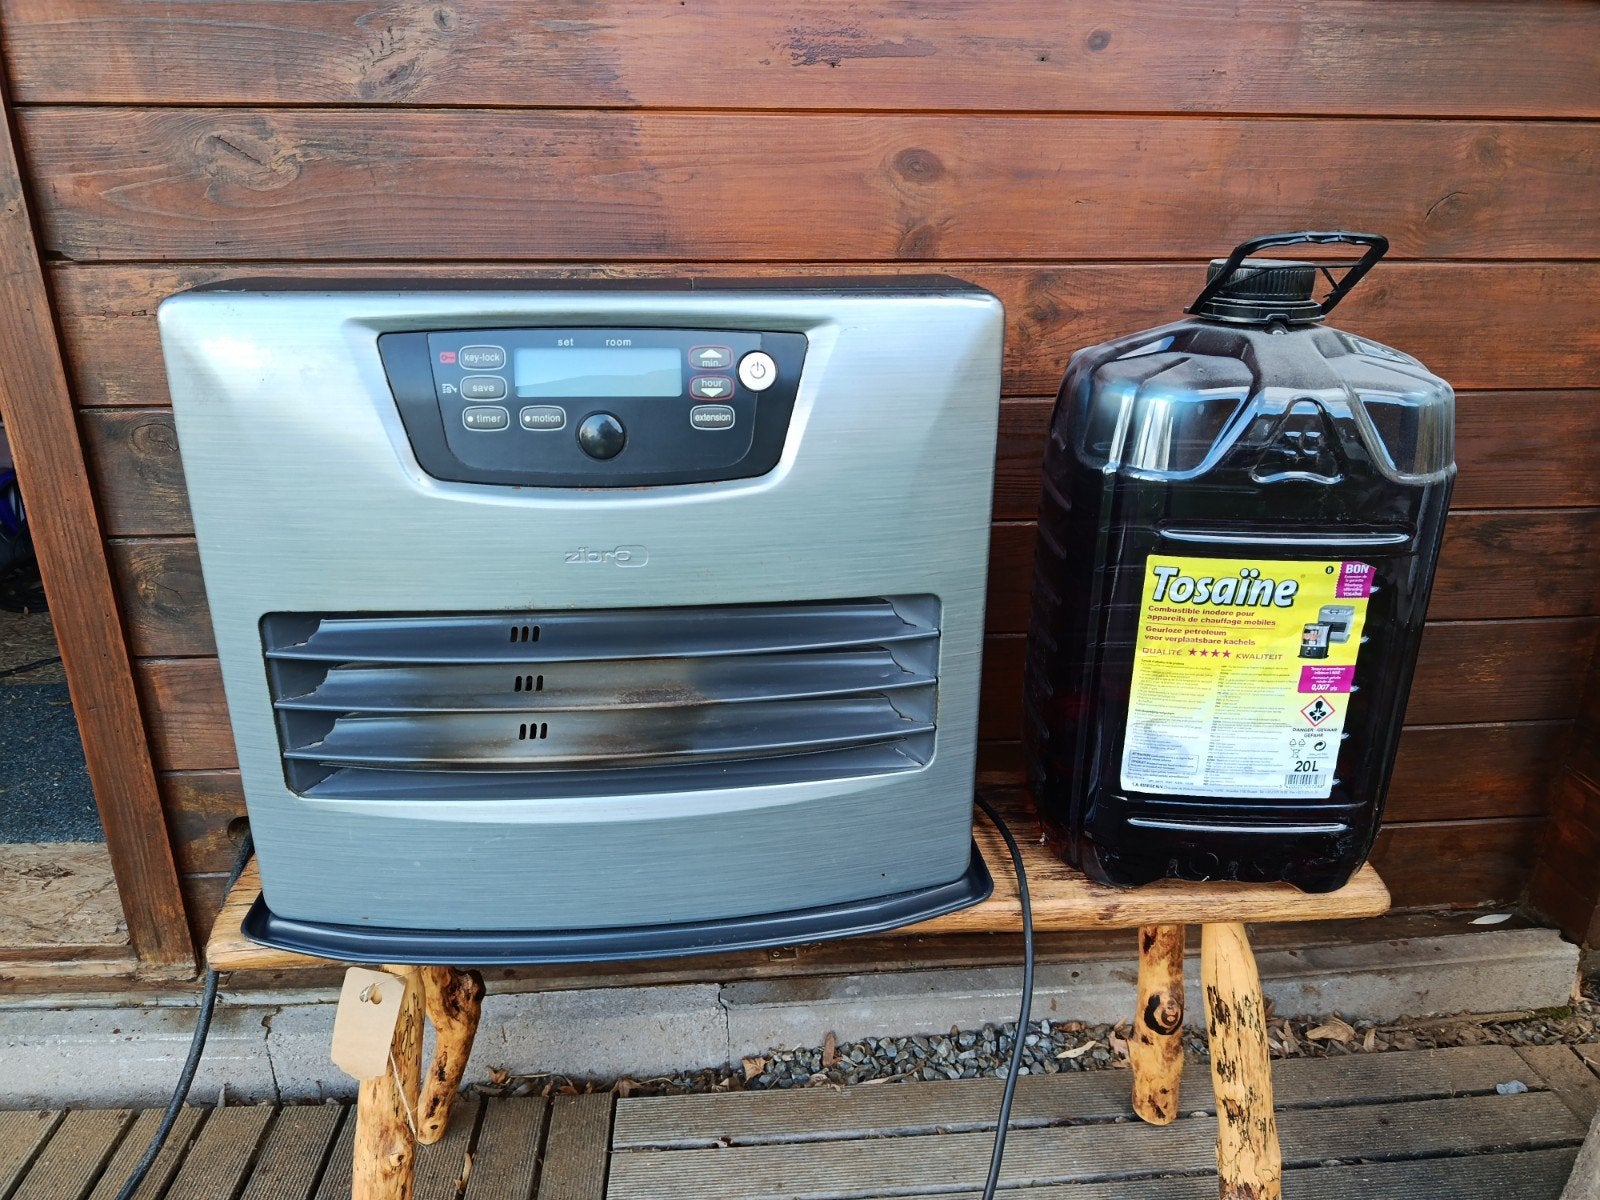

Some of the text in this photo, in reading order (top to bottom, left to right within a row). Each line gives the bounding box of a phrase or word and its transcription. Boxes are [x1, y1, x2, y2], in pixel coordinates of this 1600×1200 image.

[557, 338, 632, 347] set room
[464, 353, 501, 363] key-lock
[702, 358, 722, 367] min.
[472, 384, 495, 392] save
[701, 379, 723, 387] hour
[476, 414, 502, 423] timer
[532, 414, 561, 423] motion
[694, 413, 731, 422] extension
[1345, 563, 1370, 574] BON
[1153, 566, 1299, 608] Tosaïne
[1148, 605, 1200, 615] Combustible
[1202, 608, 1234, 616] inodore
[1146, 614, 1186, 623] appareils
[1200, 617, 1242, 626] chauffage
[1145, 625, 1227, 636] Geurloze petroleum
[1165, 635, 1222, 645] verplaatsbare
[1223, 638, 1256, 646] kachels
[1142, 647, 1283, 661] QUALITÉ KWALITEIT
